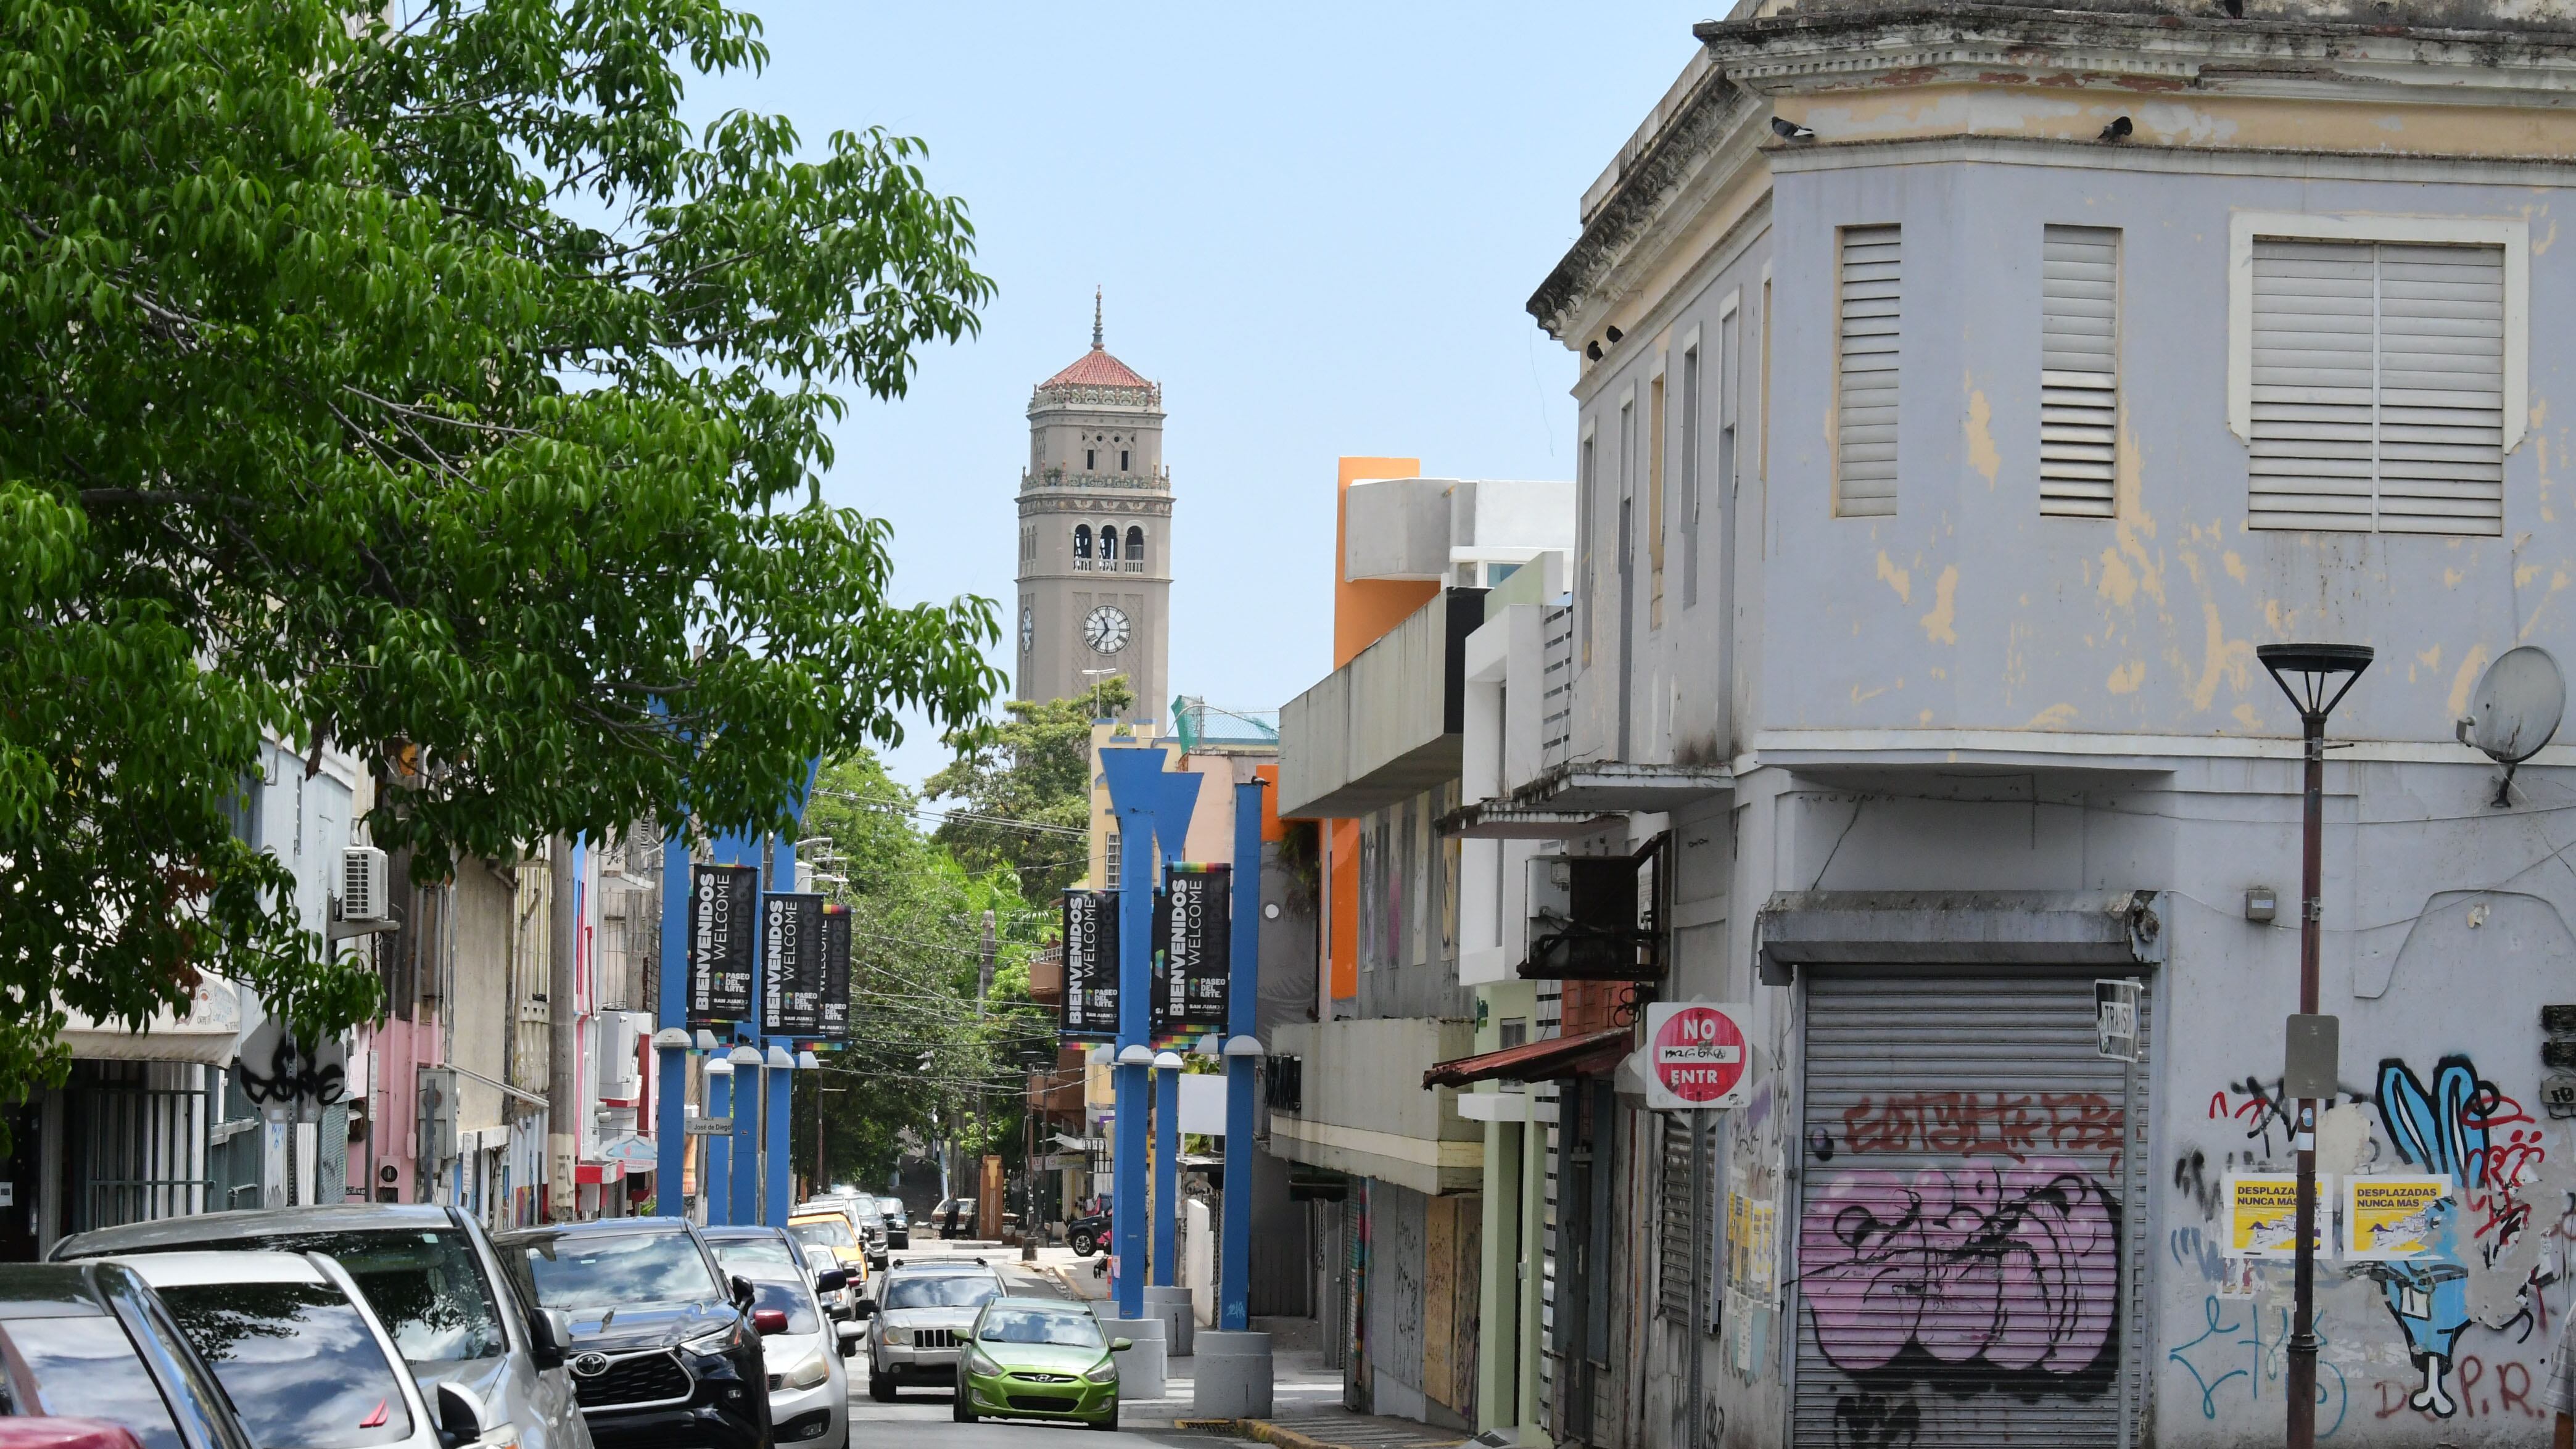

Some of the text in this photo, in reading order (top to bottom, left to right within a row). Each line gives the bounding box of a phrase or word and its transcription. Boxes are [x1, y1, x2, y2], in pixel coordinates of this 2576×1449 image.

[695, 873, 715, 1010] BIENVENIDOS
[713, 874, 730, 960] WELCOME
[783, 901, 798, 981] WELCOME
[1083, 898, 1096, 978] WELCOME
[1170, 878, 1187, 1017] BIENVENIDOS
[1188, 880, 1202, 967] WELCOME
[725, 972, 750, 980] PASEO
[766, 900, 783, 1027] BIENVENIDOS
[1069, 897, 1083, 1024] BIENVENIDOS
[1683, 1018, 1716, 1040] NO
[2237, 1197, 2275, 1205] NUNCA
[2357, 1188, 2437, 1197] DESPLAZADAS
[2357, 1197, 2419, 1207] NUNCA MÁS
